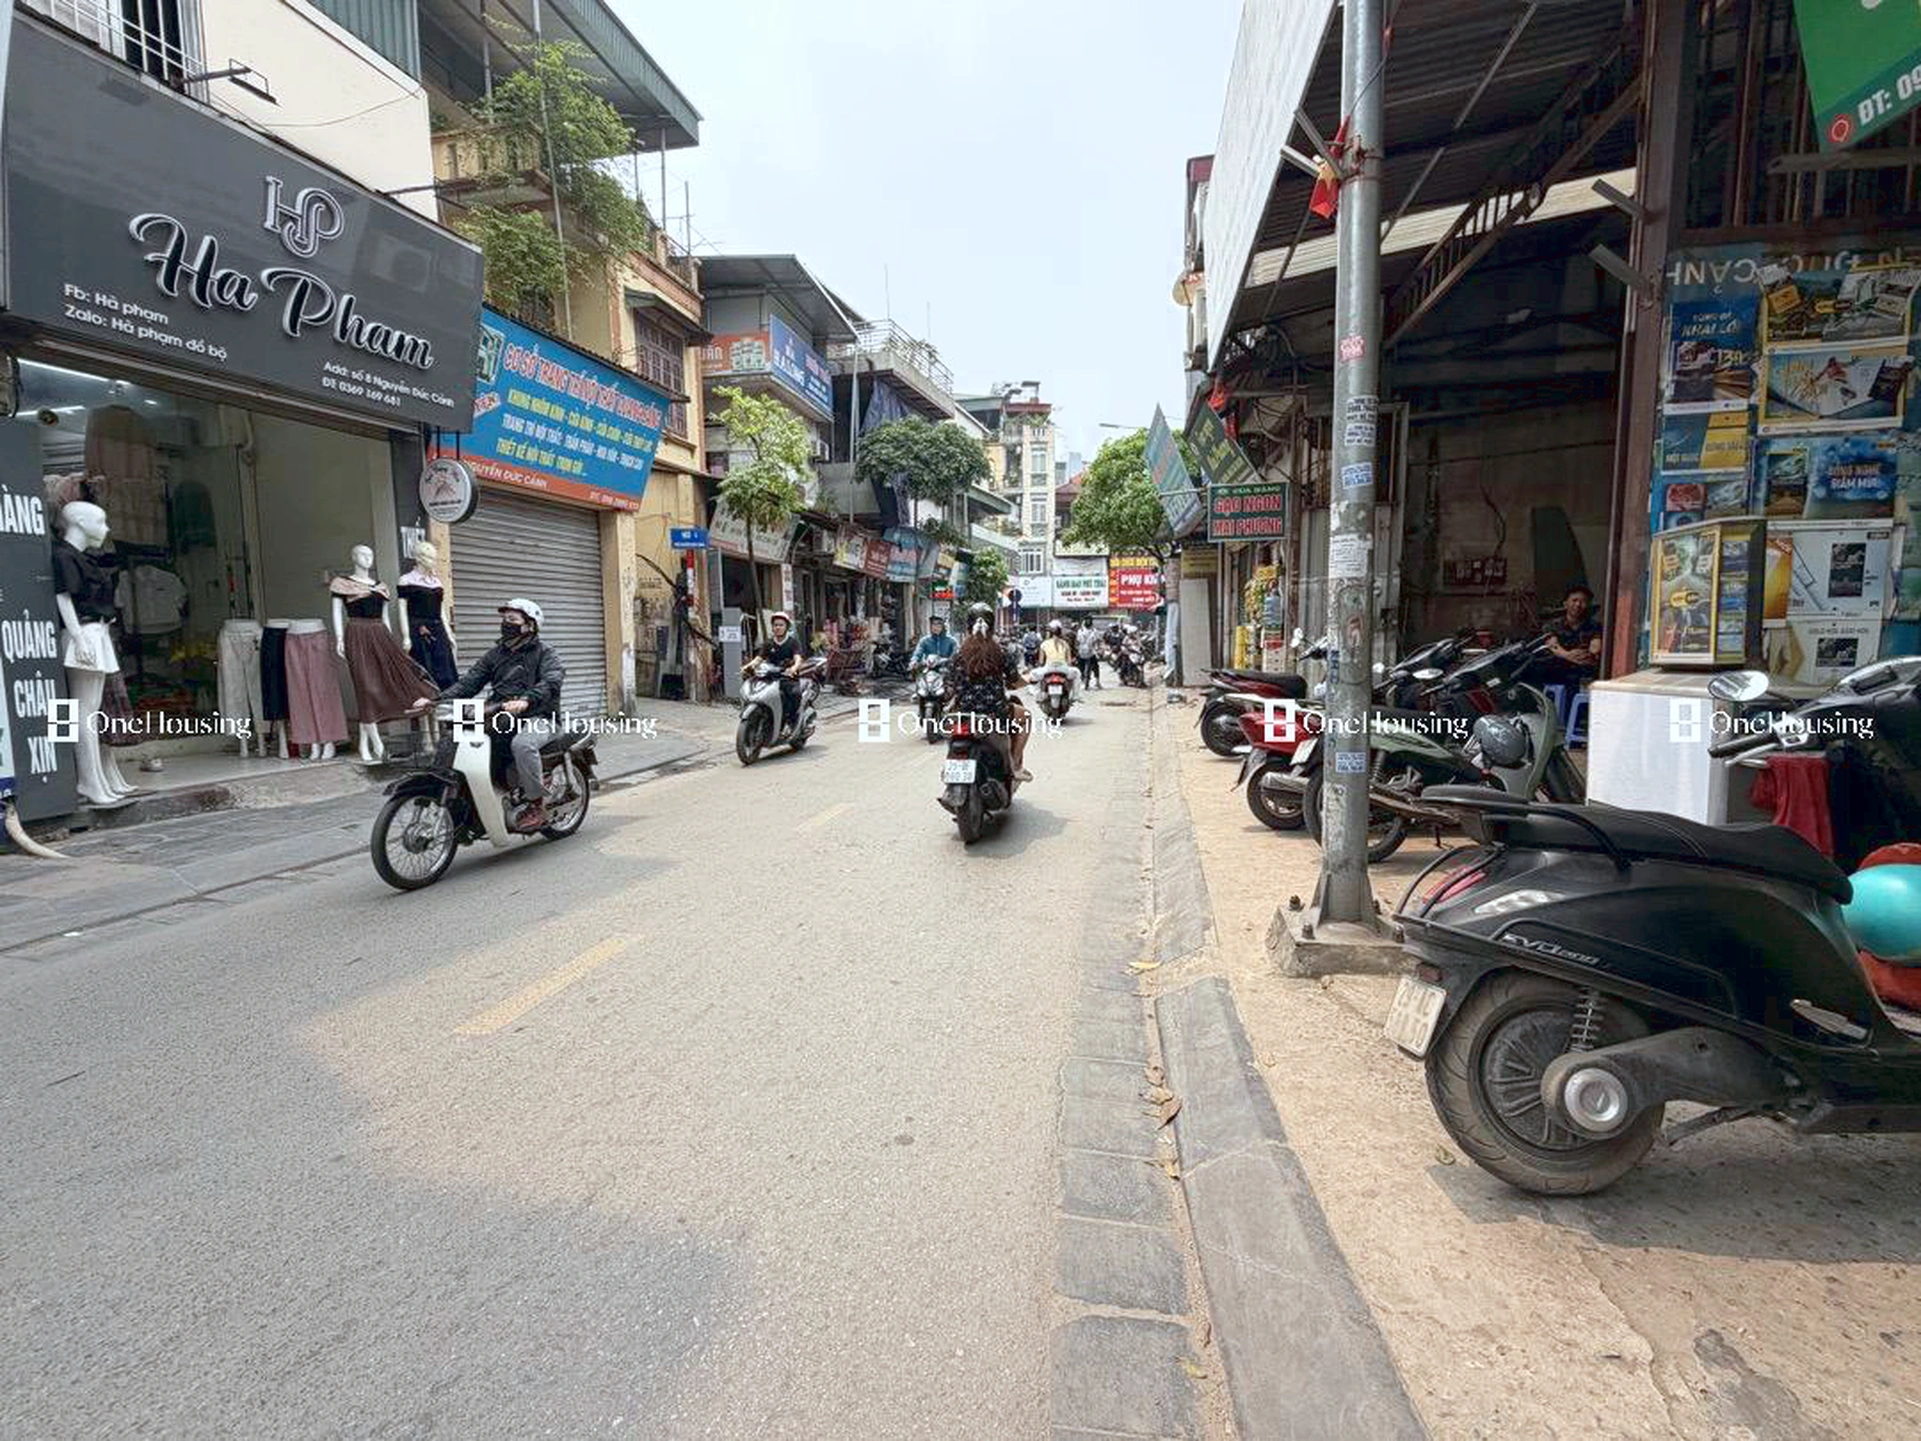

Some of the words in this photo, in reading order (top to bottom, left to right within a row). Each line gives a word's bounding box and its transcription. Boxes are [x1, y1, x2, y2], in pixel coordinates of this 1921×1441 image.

[64, 284, 91, 302] Fb:
[122, 303, 169, 325] phạm
[129, 213, 258, 311] Ha
[260, 268, 434, 370] Pham
[64, 304, 108, 326] Zalo:
[138, 327, 183, 347] phạm
[1, 608, 57, 664] QUẢNG
